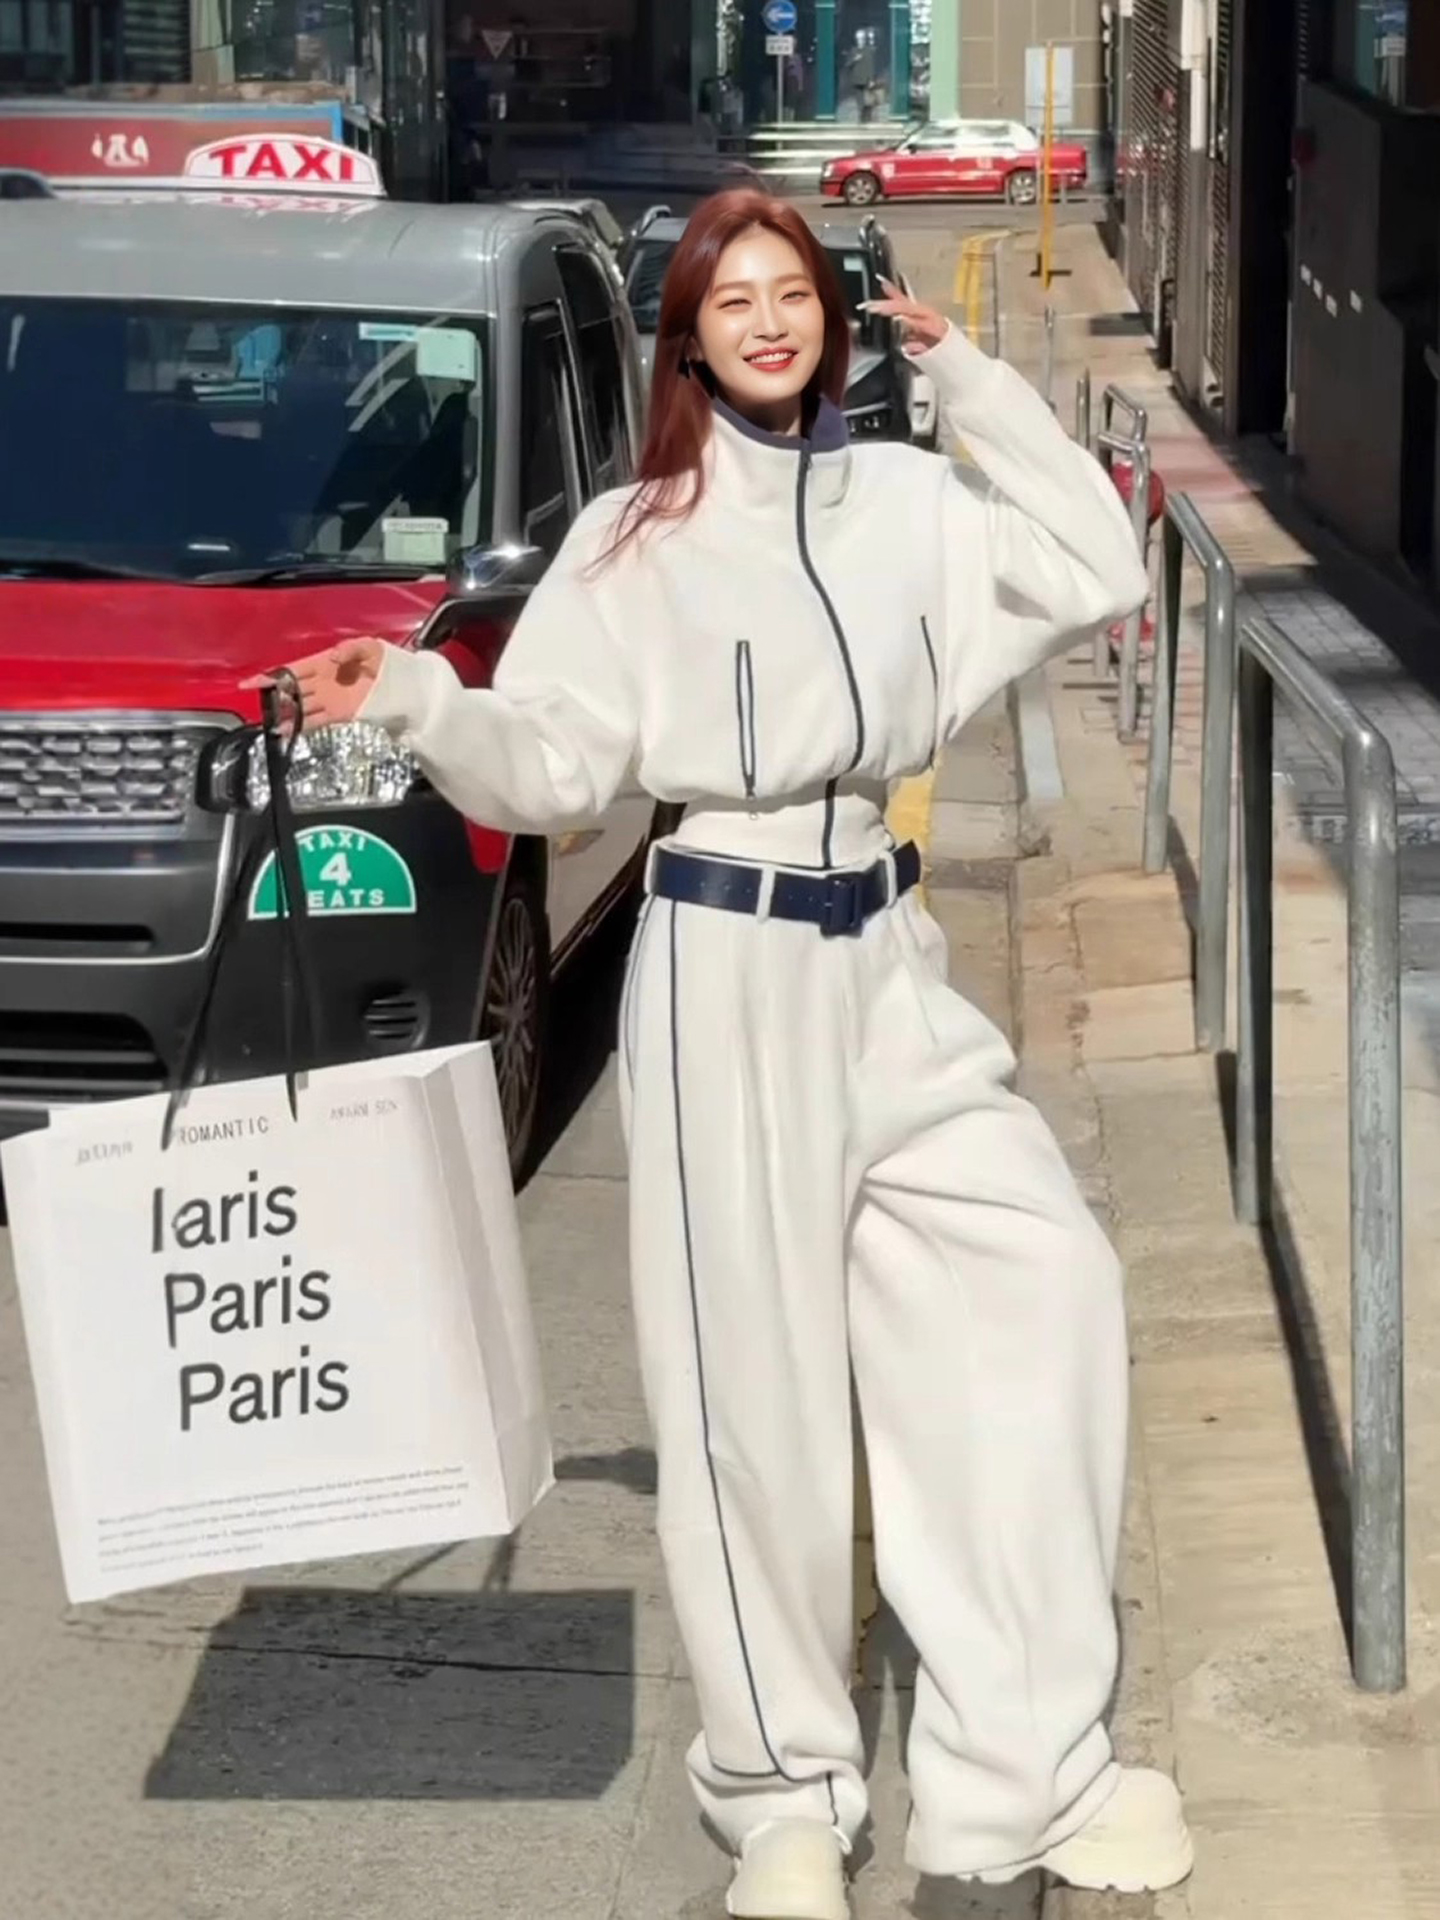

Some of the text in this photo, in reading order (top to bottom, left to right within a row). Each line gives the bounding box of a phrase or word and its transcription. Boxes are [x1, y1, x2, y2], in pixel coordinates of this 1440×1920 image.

[209, 142, 355, 181] TAXI
[297, 831, 367, 853] TAXI
[319, 852, 352, 887] 4
[307, 888, 385, 909] EATS
[164, 1254, 331, 1349] Paris
[180, 1345, 350, 1432] Paris
